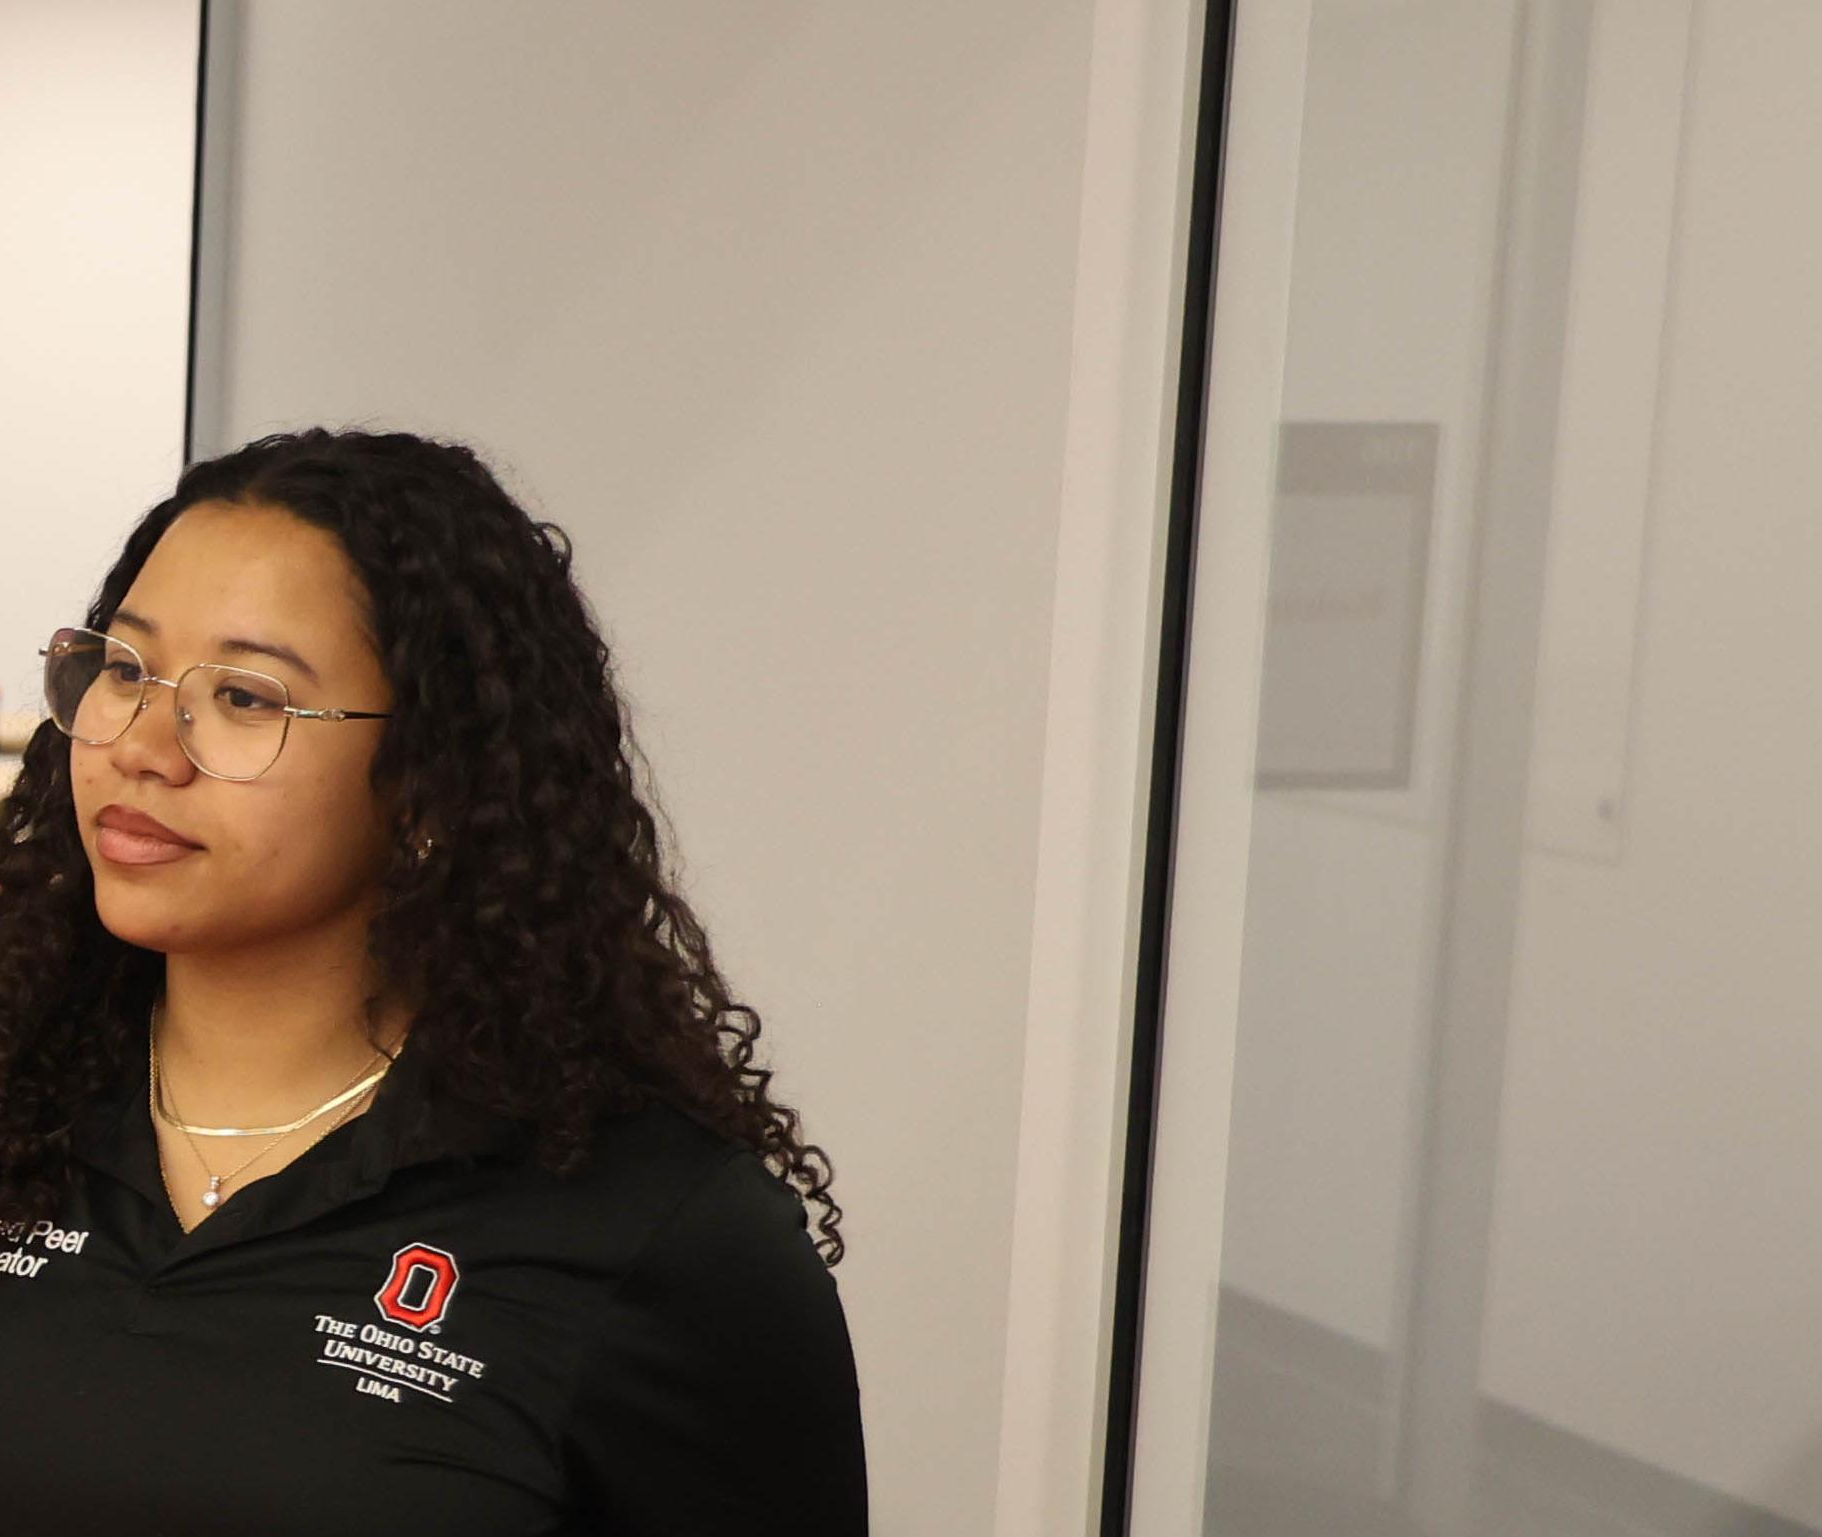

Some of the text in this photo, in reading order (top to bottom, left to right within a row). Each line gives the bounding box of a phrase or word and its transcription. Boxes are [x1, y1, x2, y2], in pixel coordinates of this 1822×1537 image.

[26, 1220, 89, 1255] Peer
[314, 1314, 484, 1380] THE OHIO STATE
[323, 1339, 459, 1394] UNIVERSITY
[356, 1376, 400, 1403] LIMA
